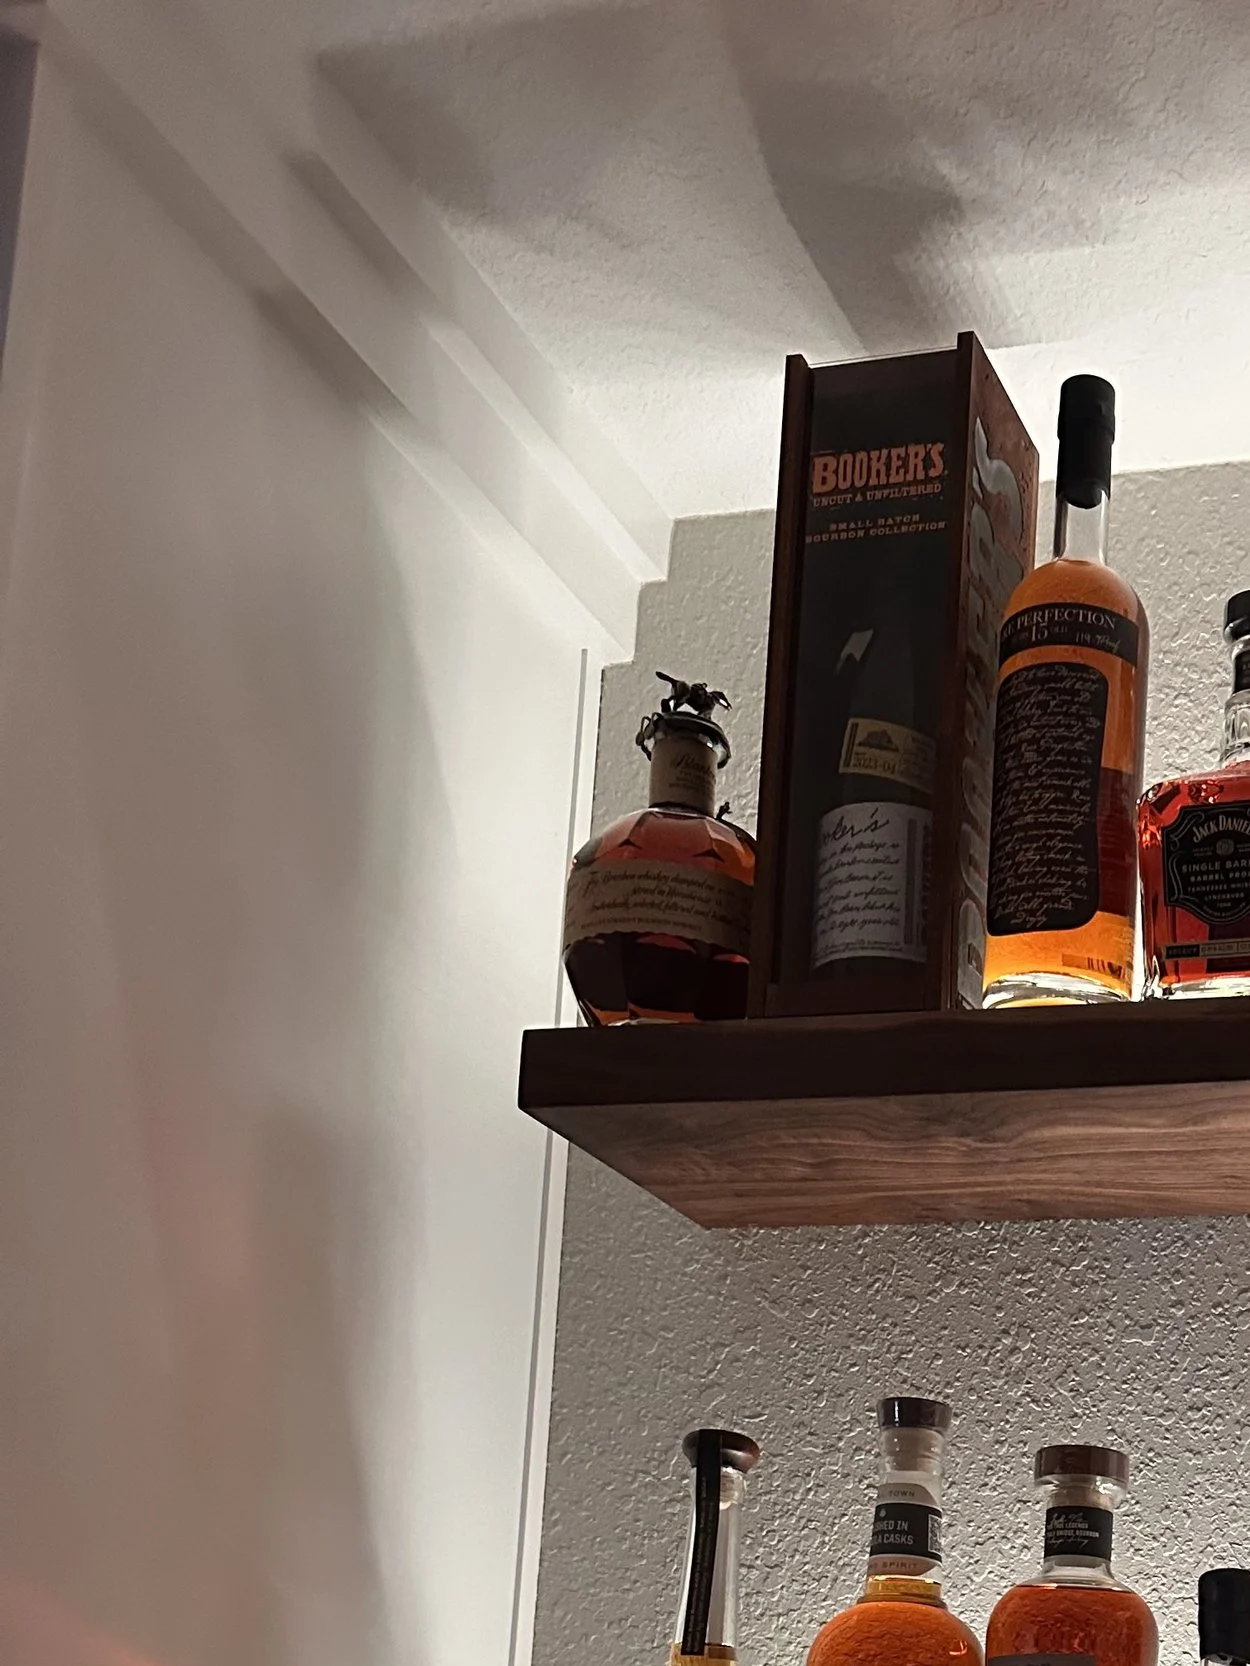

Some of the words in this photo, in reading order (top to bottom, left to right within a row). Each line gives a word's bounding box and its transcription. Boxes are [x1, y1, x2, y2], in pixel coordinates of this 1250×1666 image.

[813, 442, 945, 494] BOOKER'S
[813, 494, 852, 507] UNCUT
[867, 484, 942, 500] UNFILTERED
[870, 521, 946, 536] COLLECTION
[1018, 608, 1116, 630] PERFECTION
[1192, 821, 1218, 844] JACK
[1182, 860, 1221, 874] SINGLE
[1190, 872, 1225, 883] BARREL
[884, 1534, 913, 1545] CASKS
